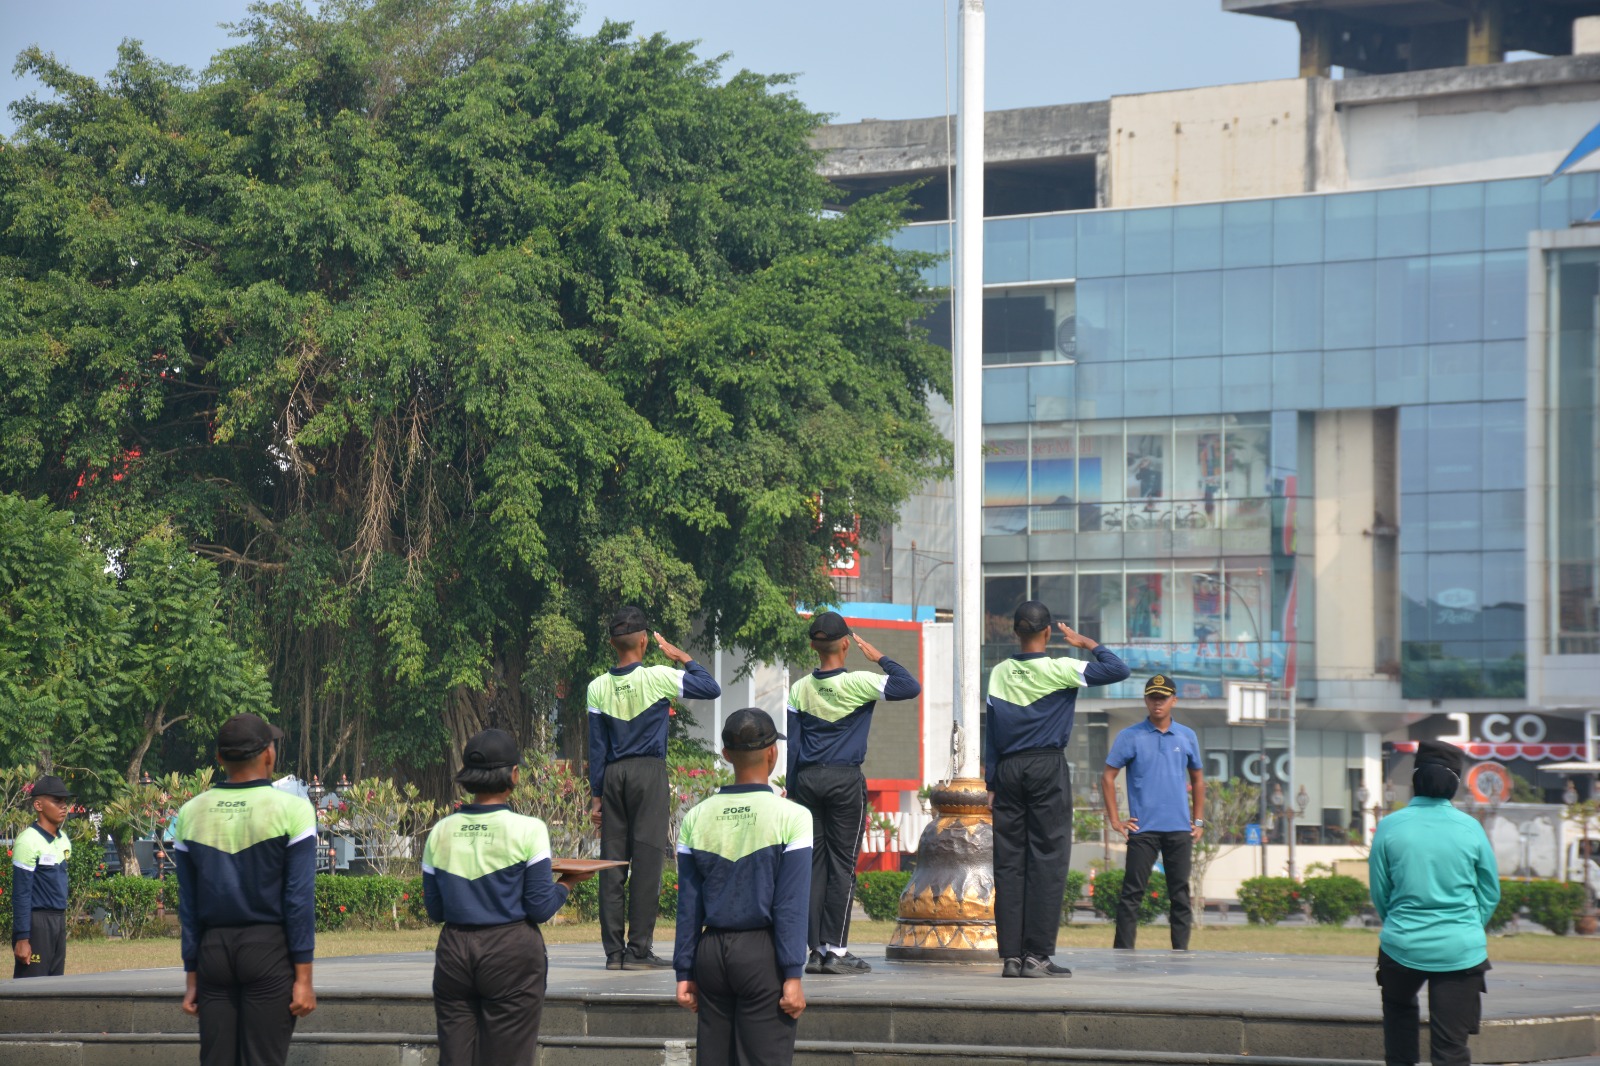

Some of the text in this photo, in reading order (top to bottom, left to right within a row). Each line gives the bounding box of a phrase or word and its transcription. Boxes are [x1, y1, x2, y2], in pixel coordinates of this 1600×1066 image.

[1004, 437, 1092, 455] SuperMll
[1436, 712, 1547, 744] J.CO
[216, 800, 247, 808] 2026
[722, 805, 751, 815] 2026
[460, 823, 489, 832] 2026
